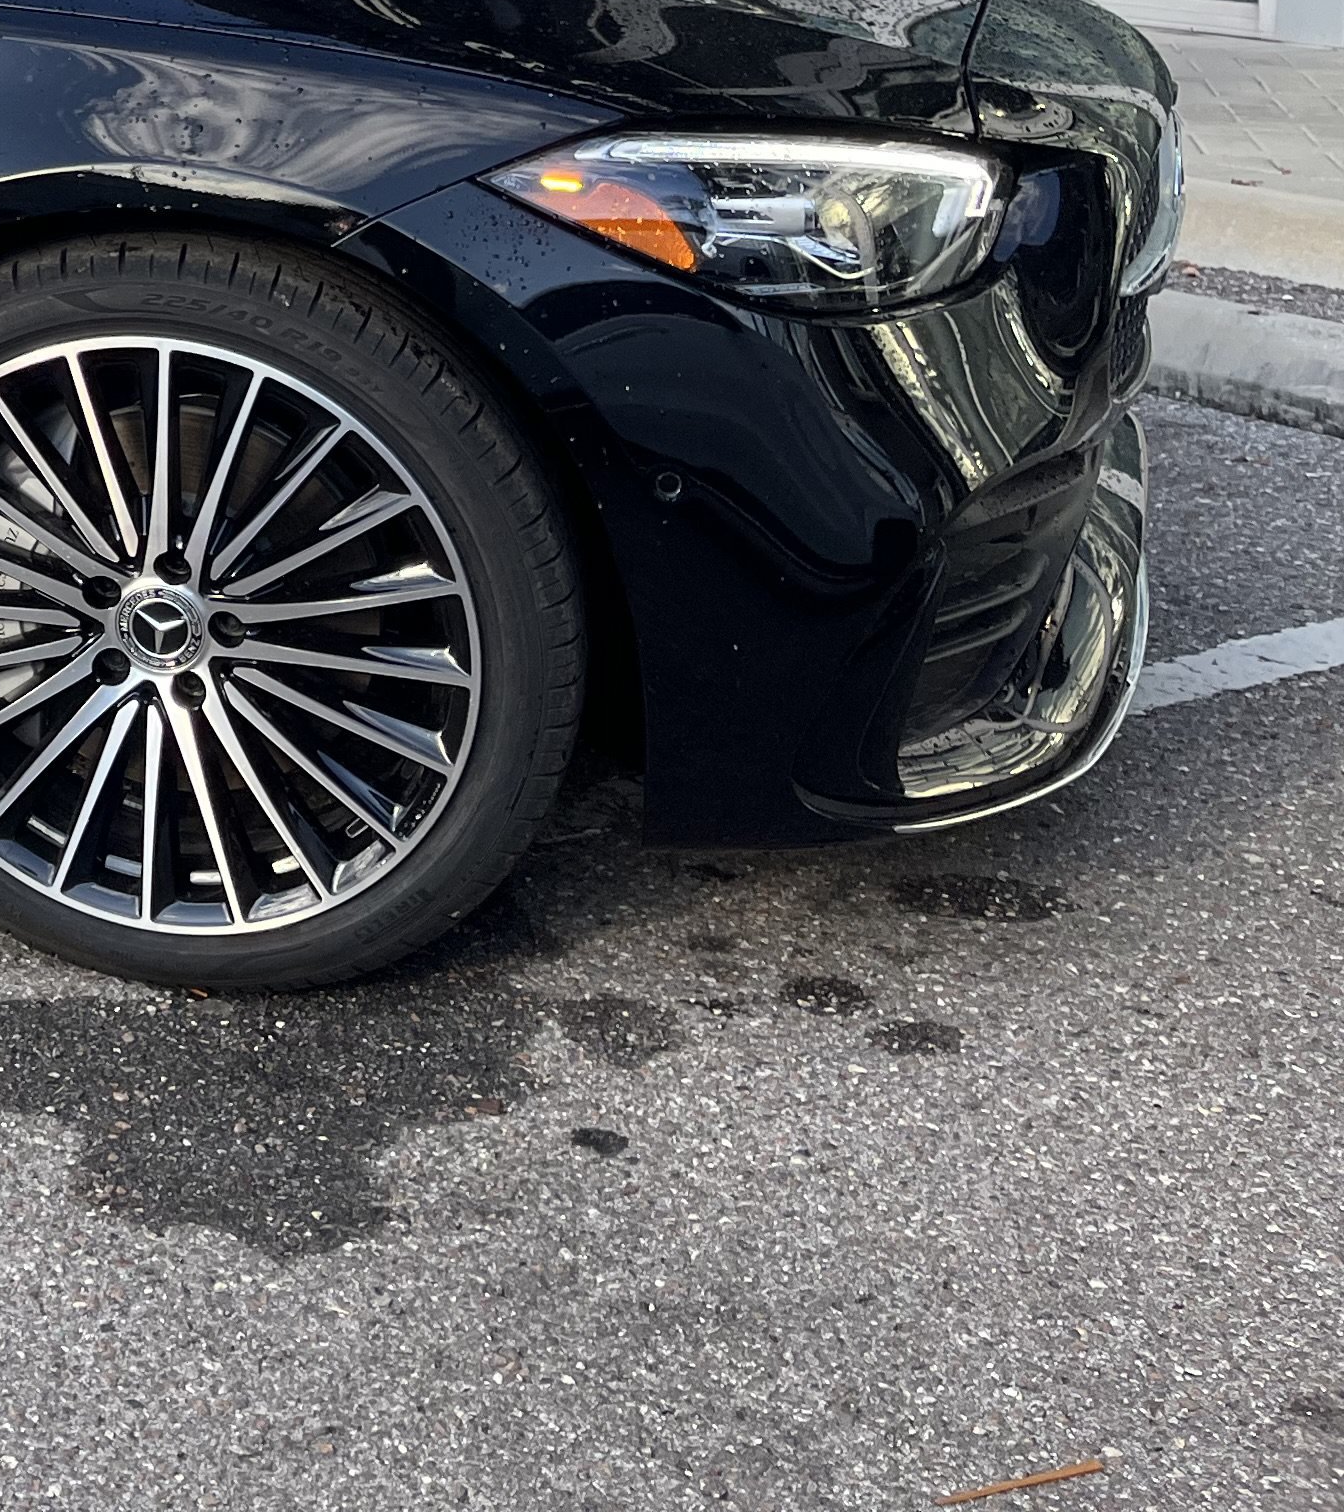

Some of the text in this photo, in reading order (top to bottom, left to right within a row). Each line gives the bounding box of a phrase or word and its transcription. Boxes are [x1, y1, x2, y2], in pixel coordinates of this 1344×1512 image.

[141, 292, 274, 330] 225/40
[119, 588, 157, 632] MERCEDES
[178, 637, 201, 664] BENZ
